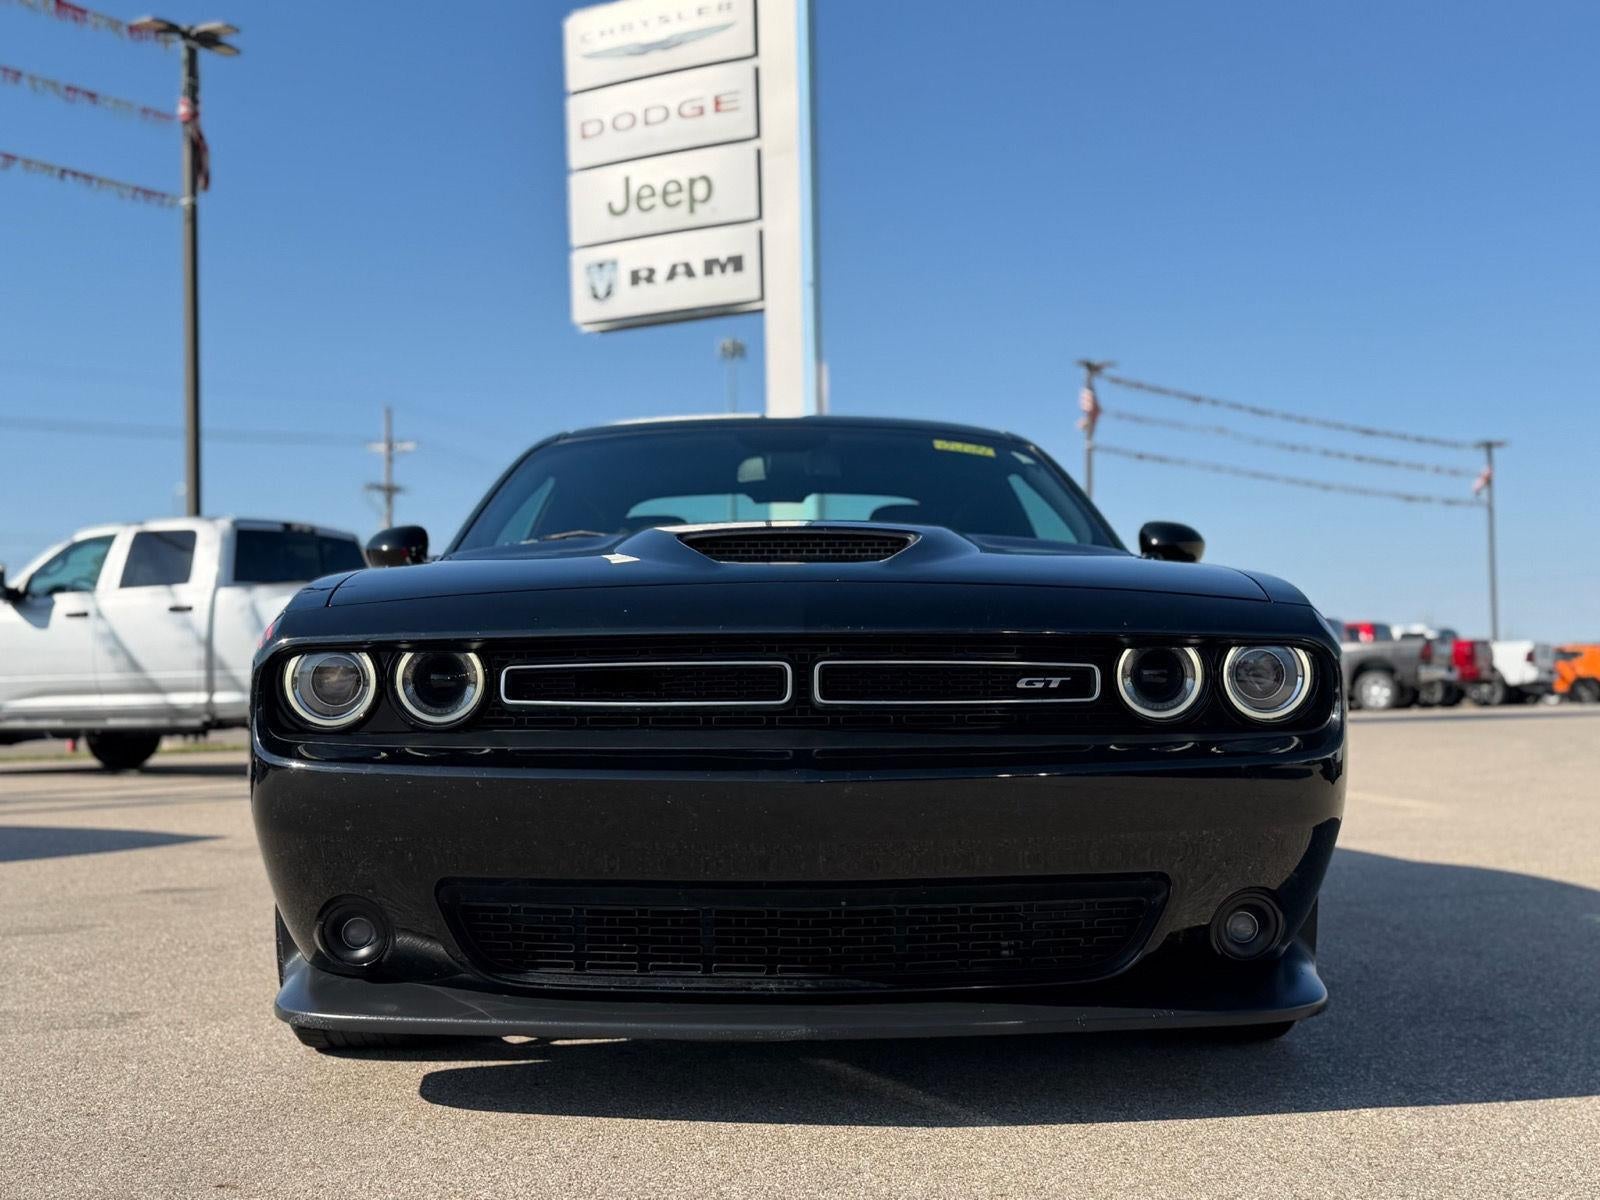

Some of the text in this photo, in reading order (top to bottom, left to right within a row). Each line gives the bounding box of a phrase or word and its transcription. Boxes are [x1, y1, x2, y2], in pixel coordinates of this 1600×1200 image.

[579, 2, 734, 44] CHRYSLER
[580, 91, 740, 139] DODGE
[607, 174, 713, 216] Jeep
[630, 254, 744, 287] RAM
[1016, 677, 1071, 688] GT
